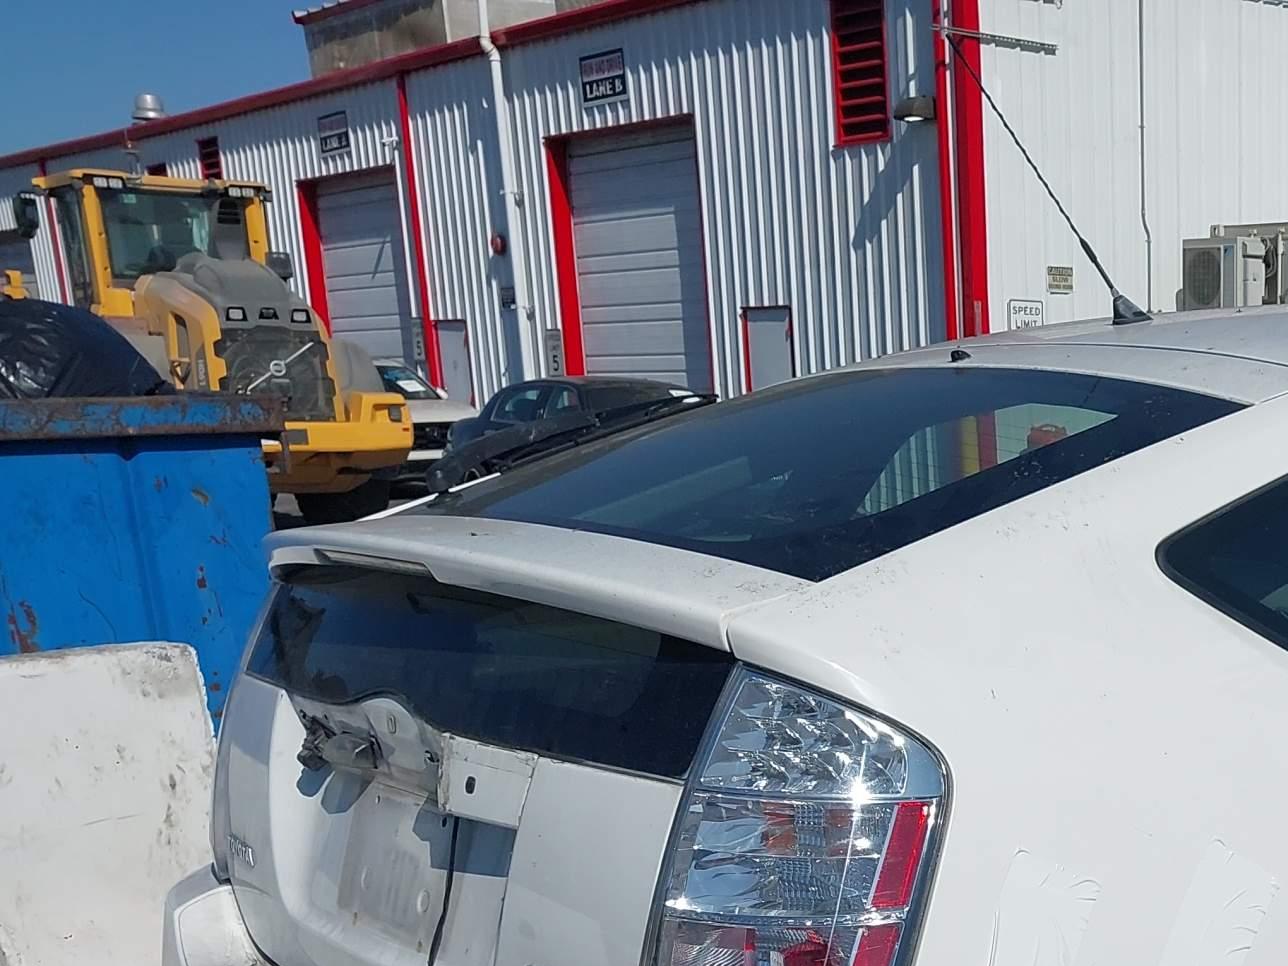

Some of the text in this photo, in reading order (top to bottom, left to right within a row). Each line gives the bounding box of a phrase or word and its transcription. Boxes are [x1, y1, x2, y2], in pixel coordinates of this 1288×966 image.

[586, 79, 623, 98] LANE B
[1012, 306, 1041, 316] SPEED
[1016, 319, 1038, 329] LIMIT
[552, 355, 560, 371] 5
